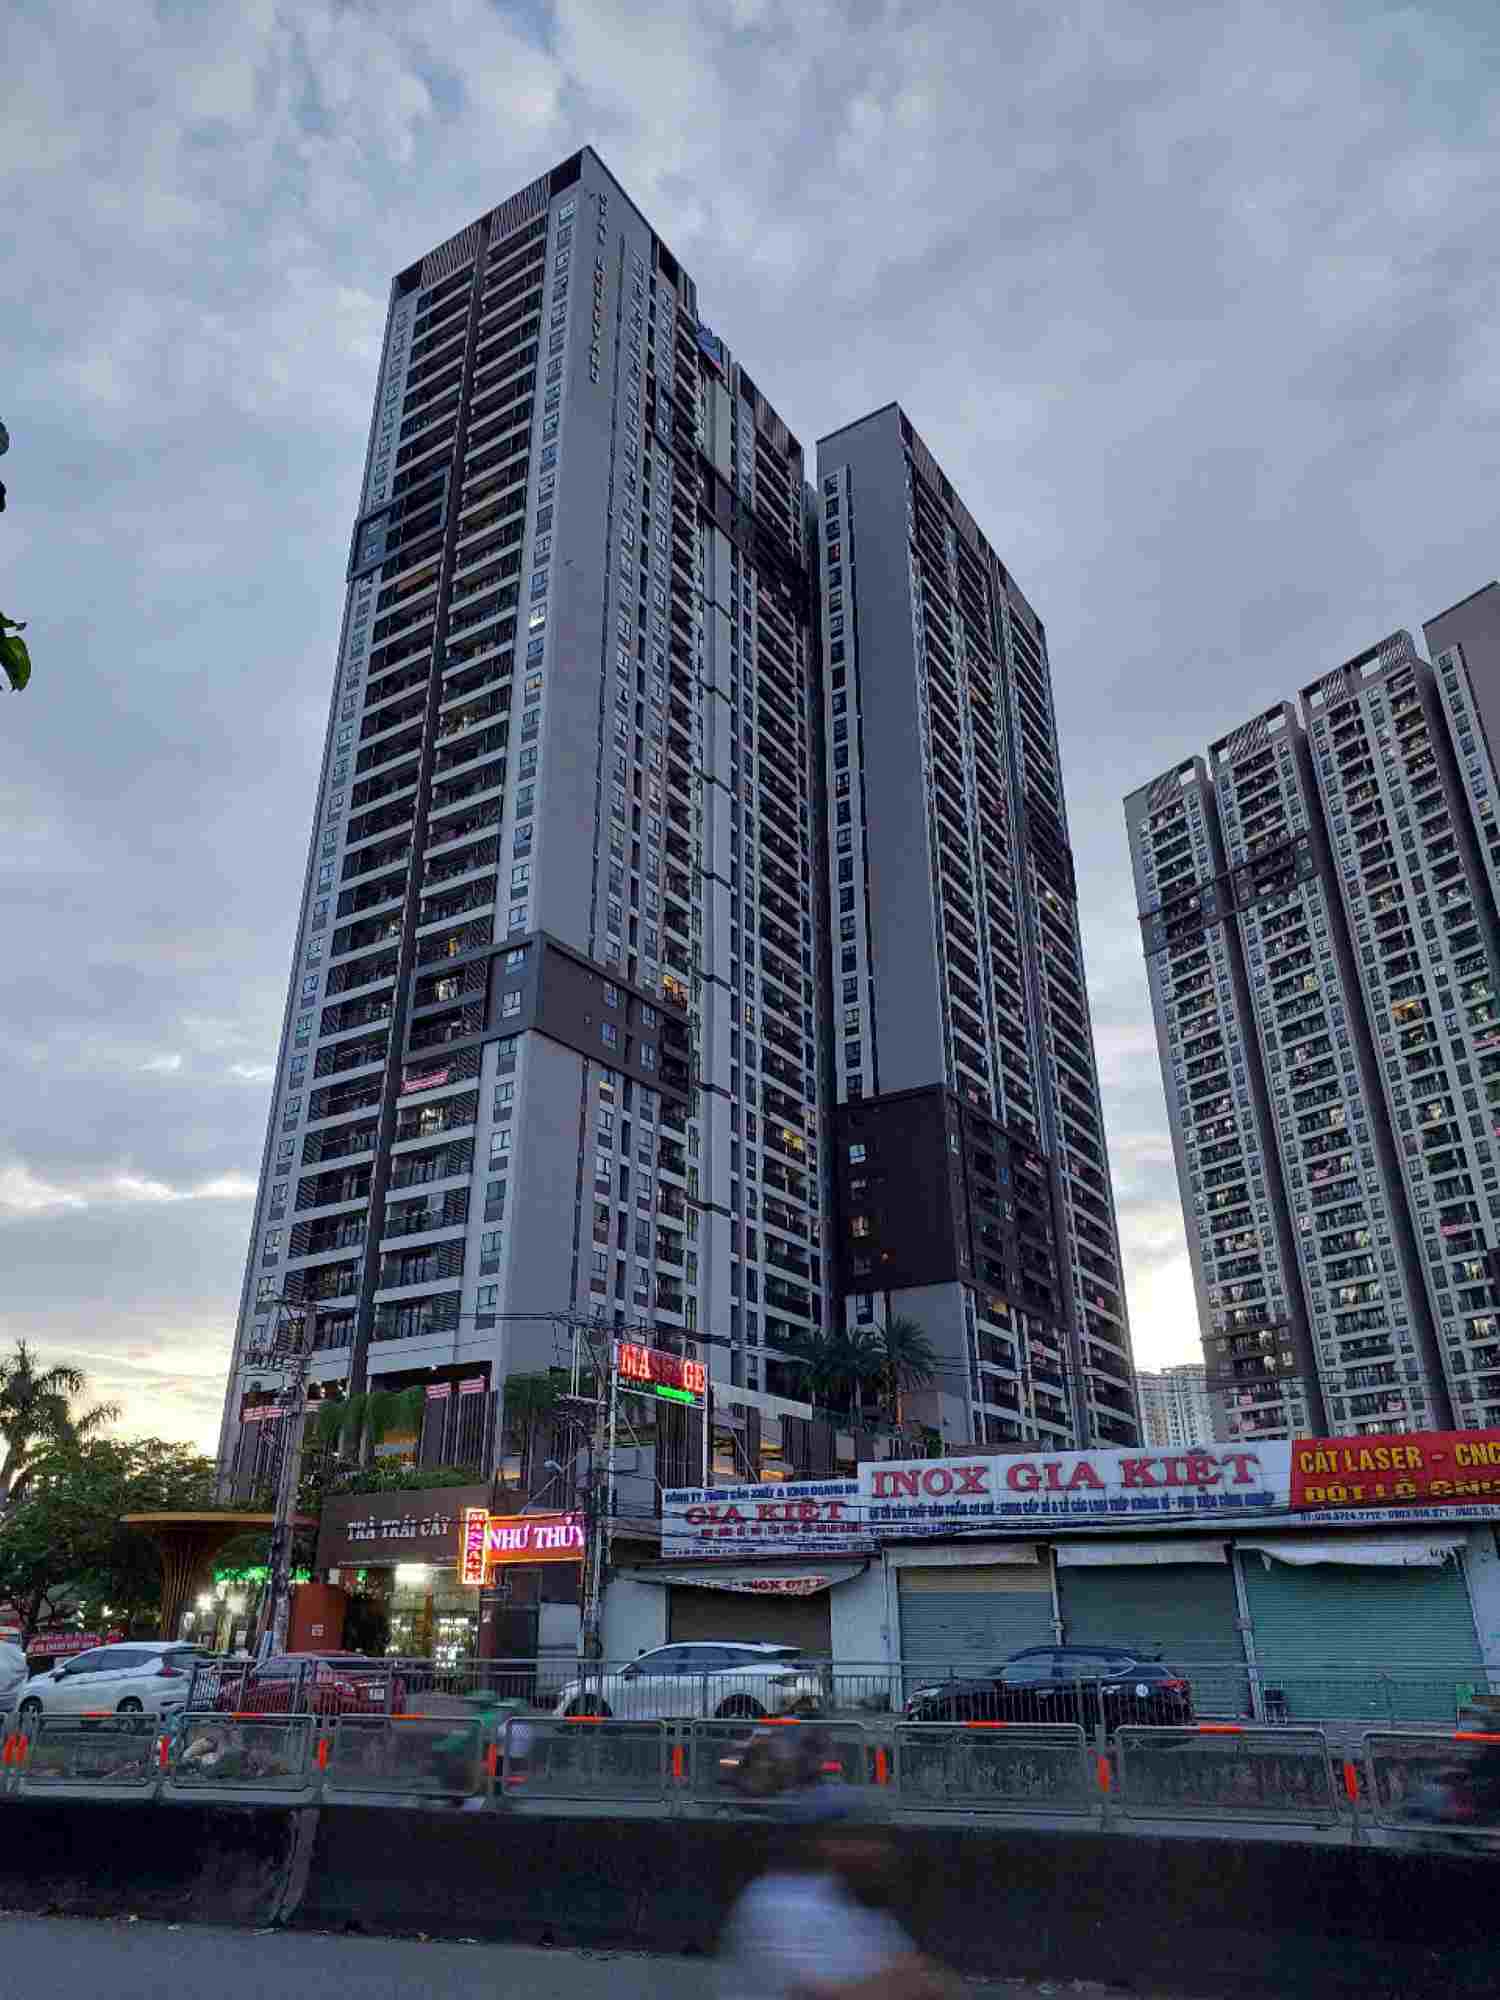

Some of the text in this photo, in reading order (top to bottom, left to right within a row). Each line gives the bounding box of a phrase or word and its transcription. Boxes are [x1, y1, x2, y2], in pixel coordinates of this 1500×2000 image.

[1343, 1446, 1425, 1472] LASER
[872, 1448, 1260, 1499] INOX GIA KIỆT
[487, 1523, 531, 1551] NHƯ
